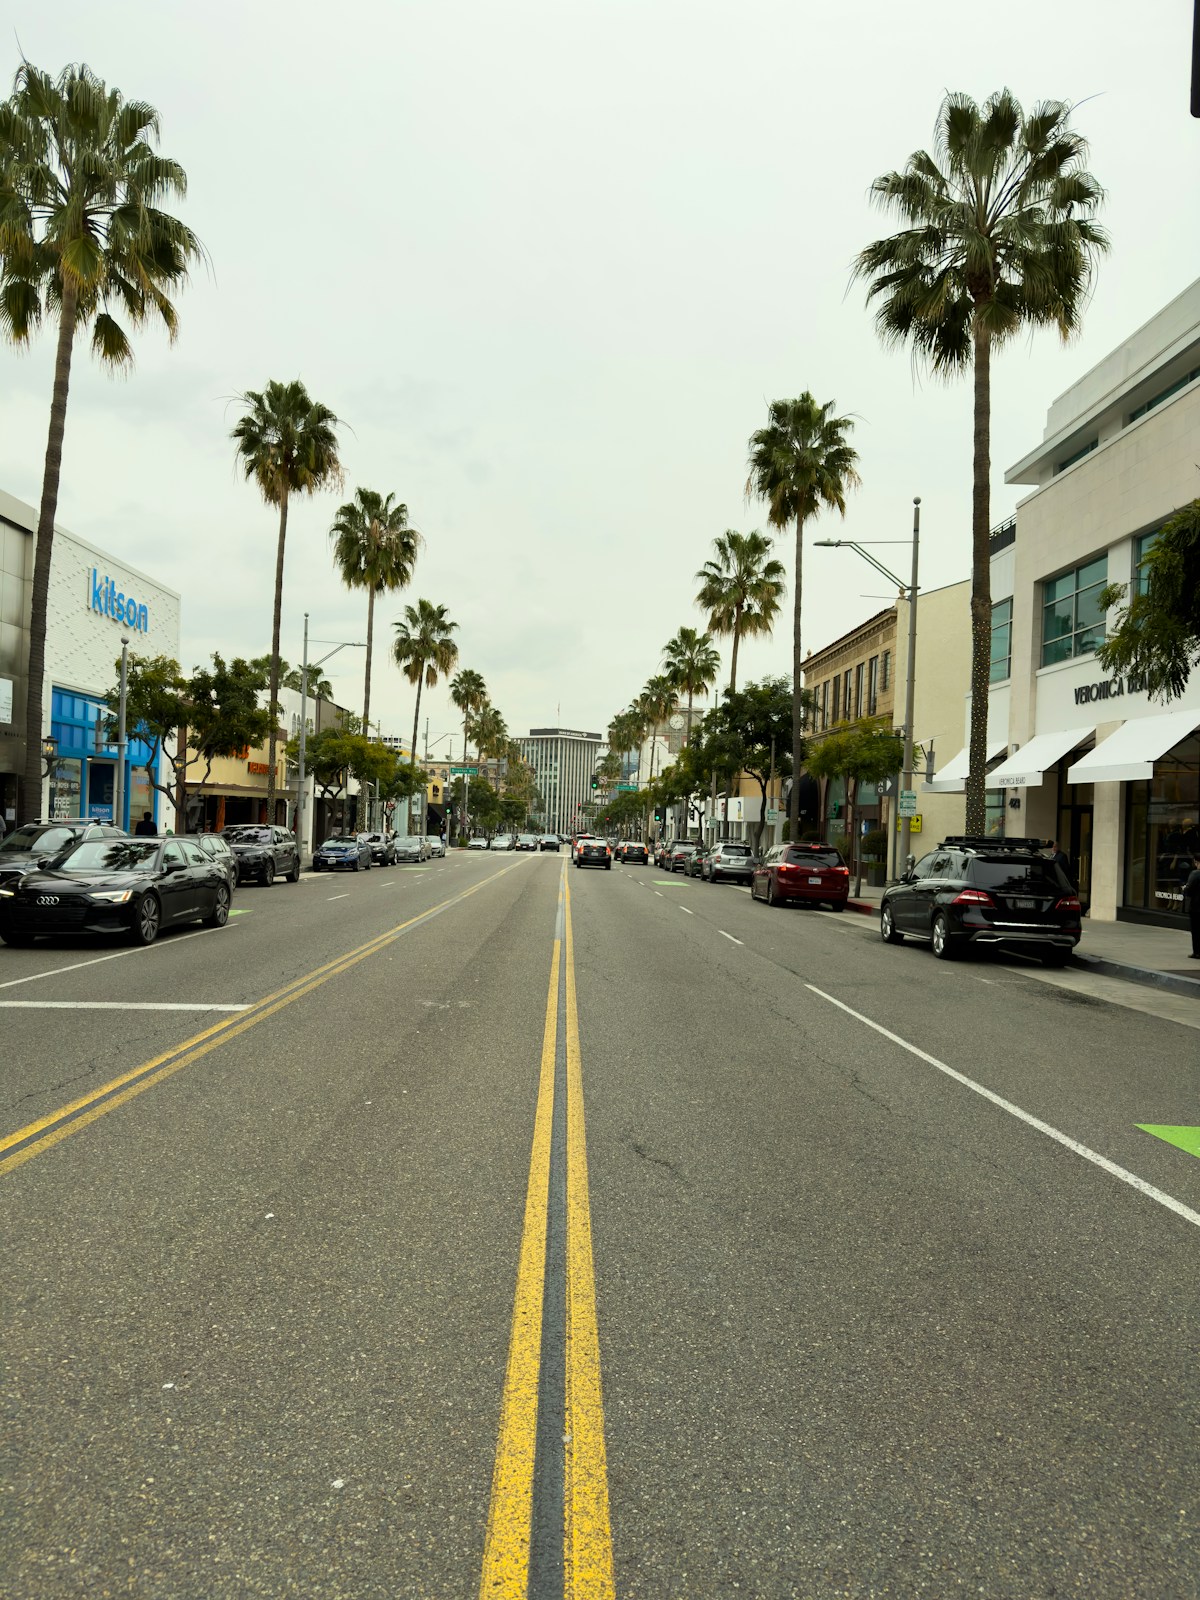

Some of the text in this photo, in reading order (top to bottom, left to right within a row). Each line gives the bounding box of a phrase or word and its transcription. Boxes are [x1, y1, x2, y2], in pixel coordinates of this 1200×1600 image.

[92, 568, 148, 633] kitson
[1074, 677, 1125, 705] VERONICA
[999, 776, 1026, 786] VERONICA BEARD
[54, 797, 70, 808] FREE
[54, 810, 70, 819] CITY
[1155, 891, 1184, 901] VERONICA BEARD
